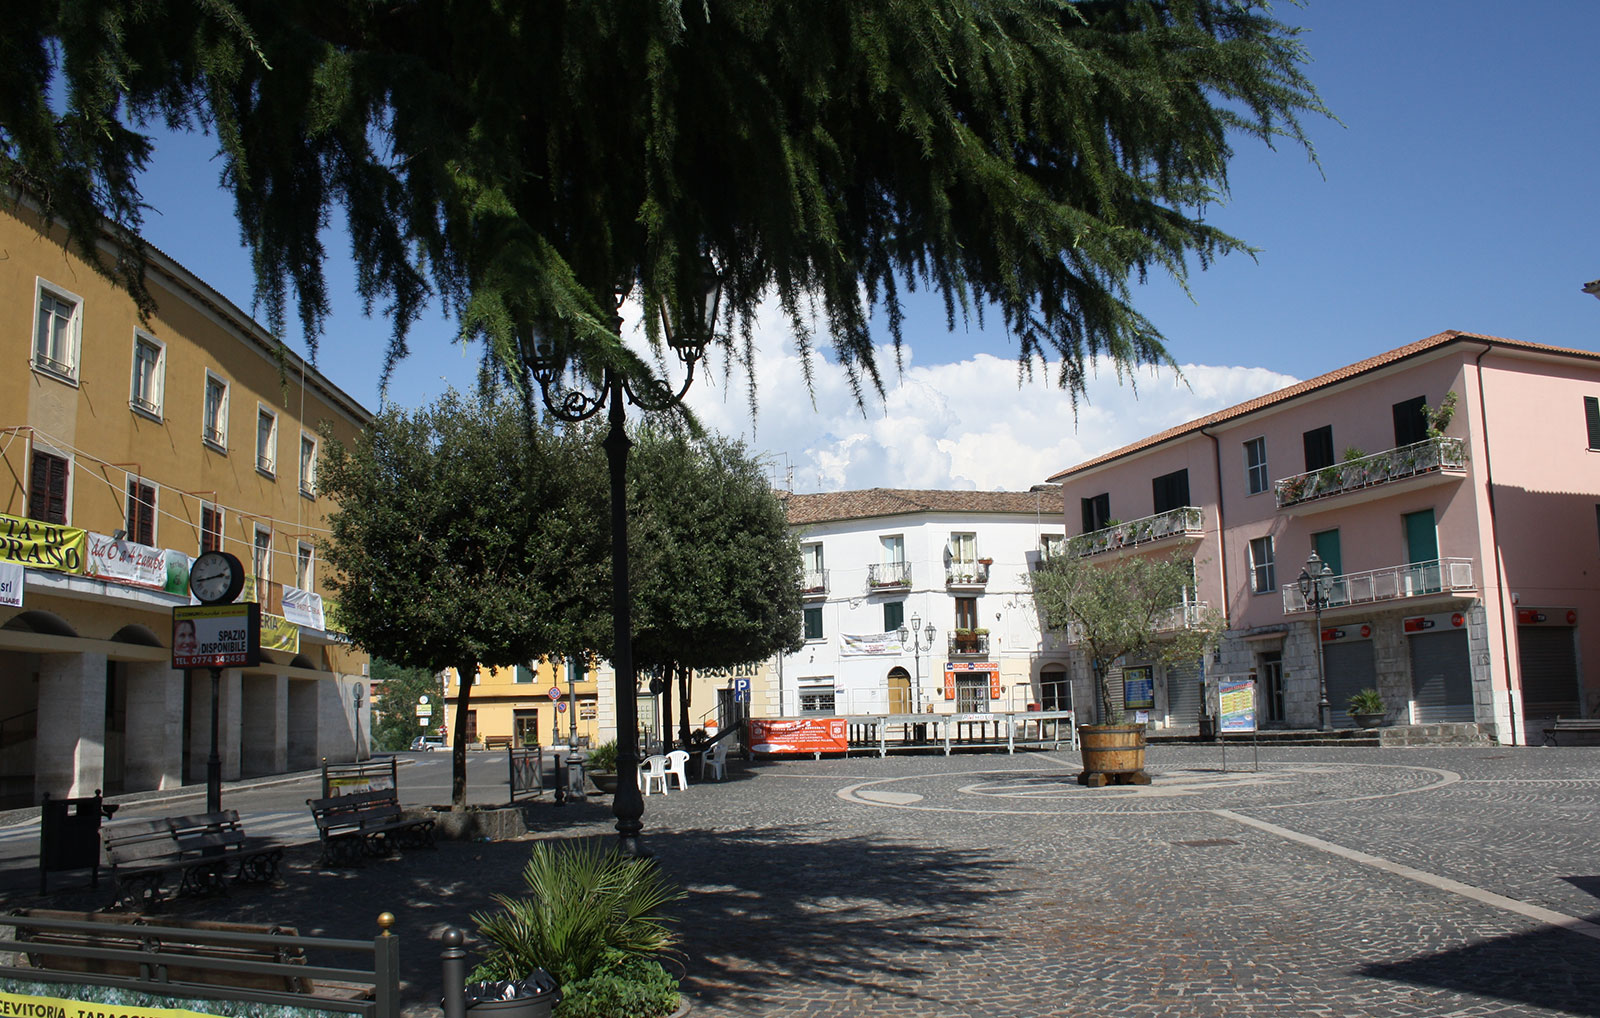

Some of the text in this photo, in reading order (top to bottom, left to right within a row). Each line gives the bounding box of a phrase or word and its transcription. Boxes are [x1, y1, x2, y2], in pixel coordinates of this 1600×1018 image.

[45, 526, 65, 546] DI
[1, 580, 12, 593] srl
[218, 629, 246, 642] SPAZIO
[201, 640, 246, 654] DISPONIBILE
[175, 655, 246, 665] TEL. 0774 342458
